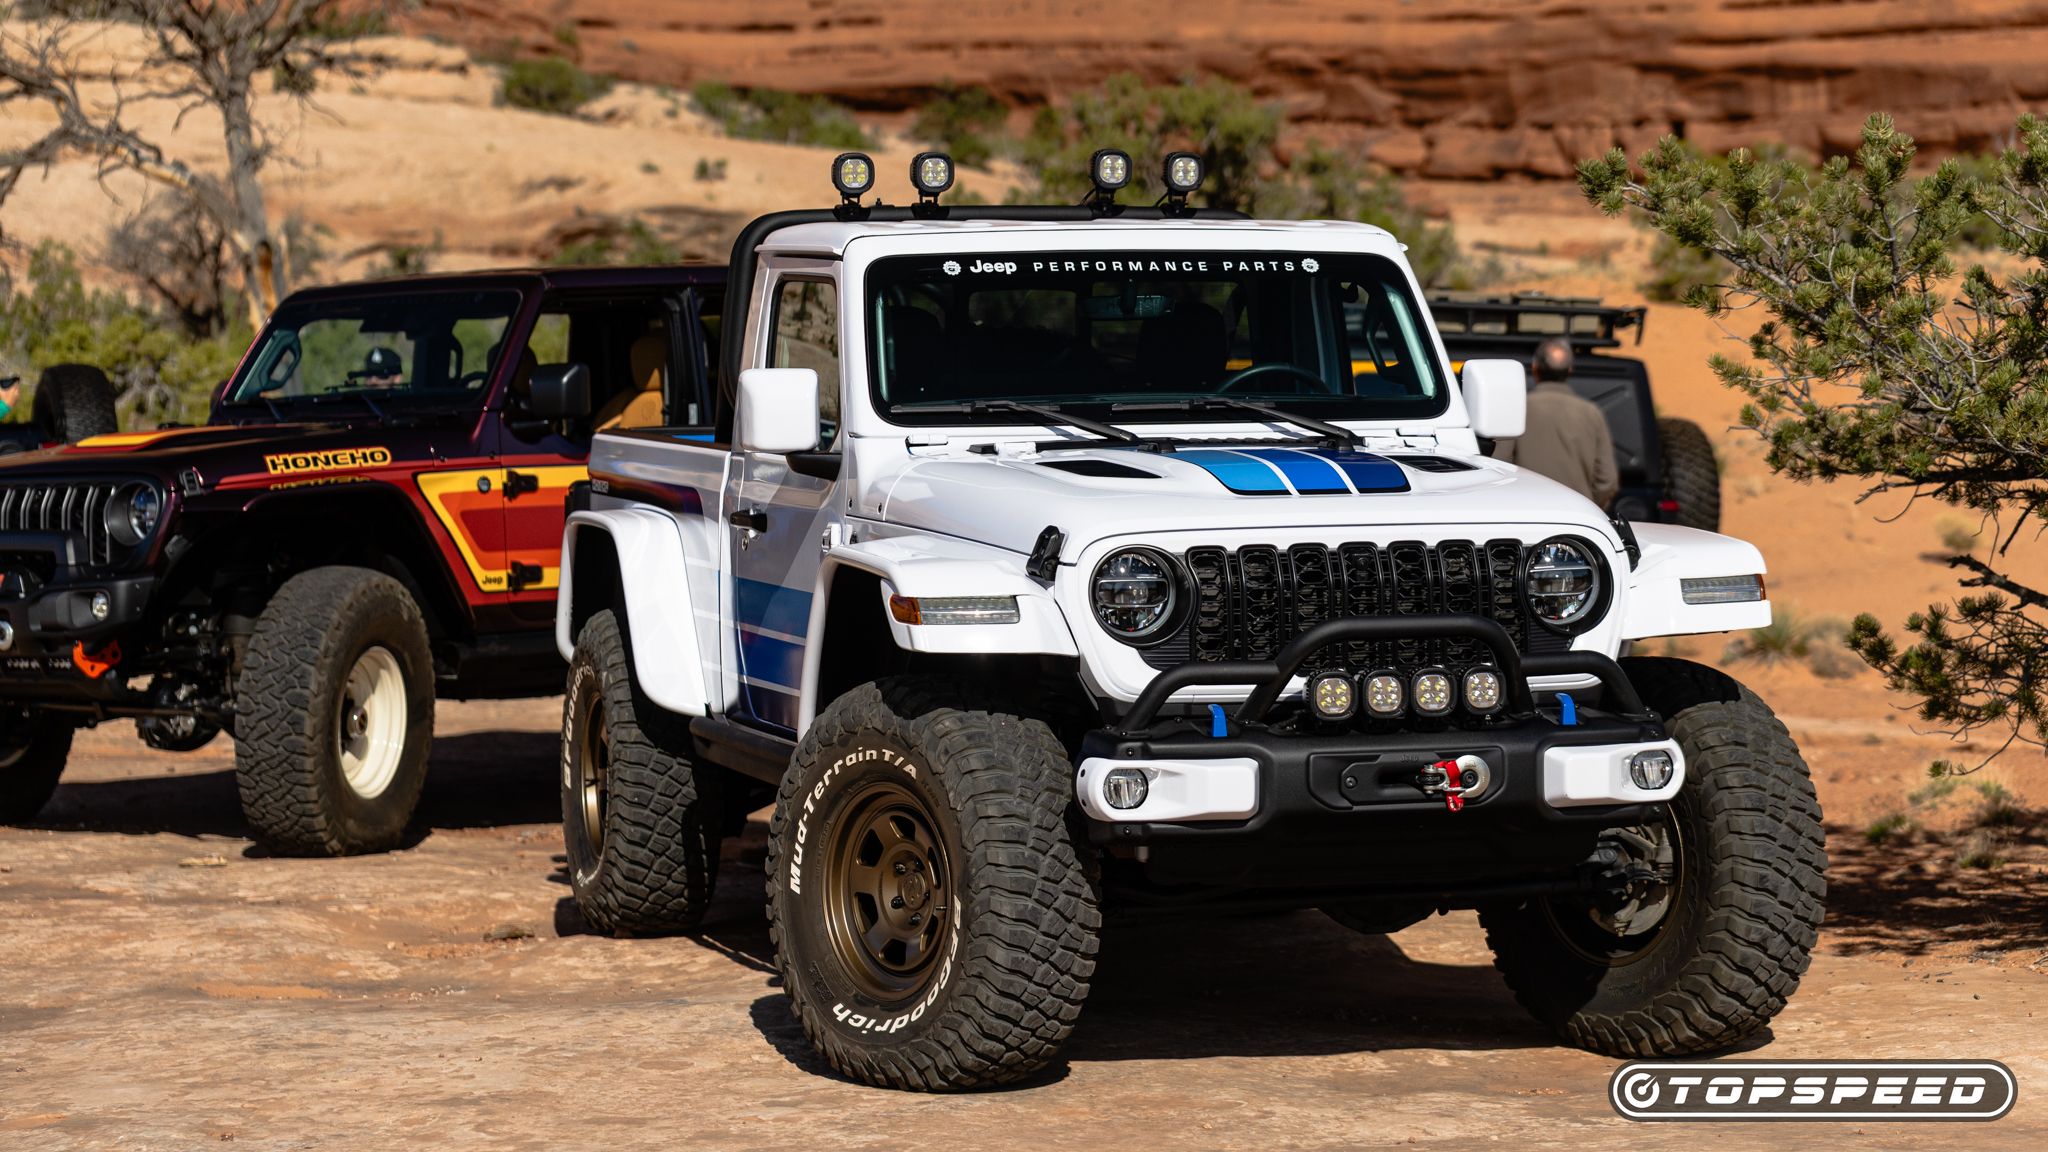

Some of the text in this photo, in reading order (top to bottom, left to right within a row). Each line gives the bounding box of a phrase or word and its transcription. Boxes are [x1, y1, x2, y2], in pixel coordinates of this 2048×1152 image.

[970, 260, 1294, 274] Jeep PERFORMANCE PARTS
[266, 448, 391, 474] HONCHO
[790, 747, 877, 895] Mud-Terrain
[882, 749, 917, 779] T/A
[832, 894, 961, 1034] BFGoodrich
